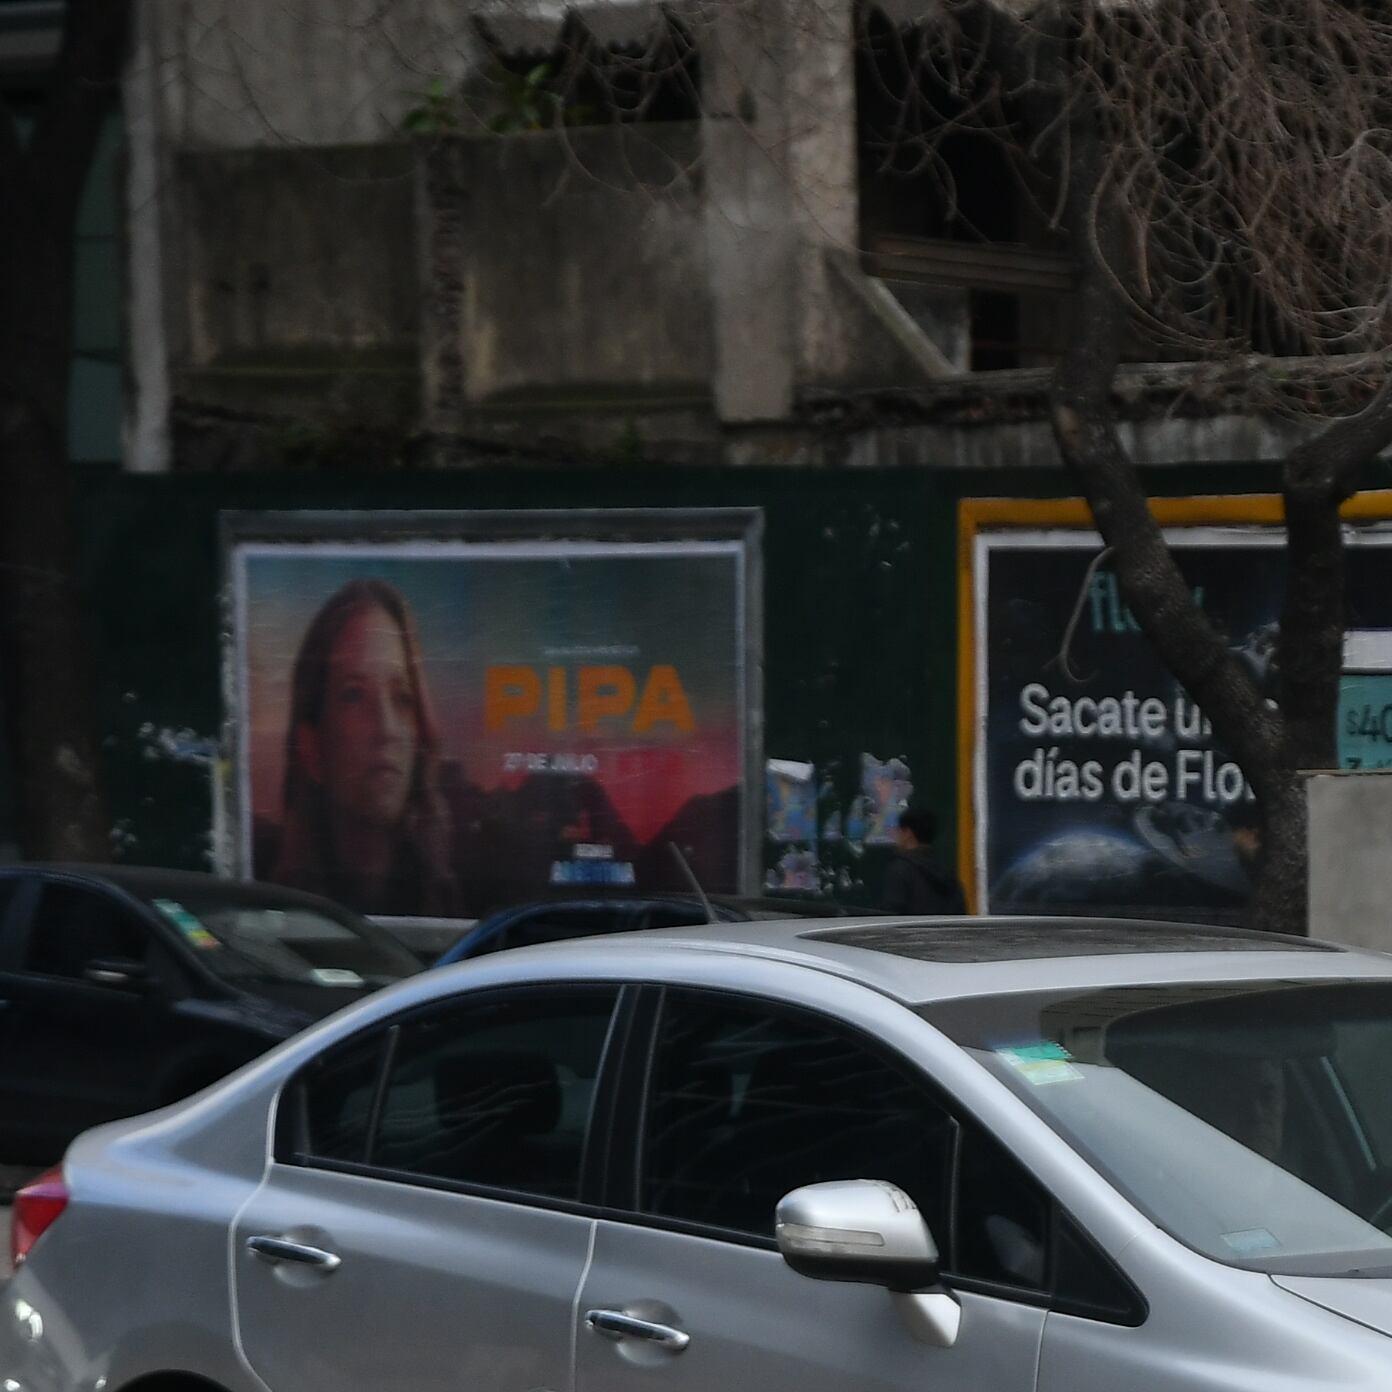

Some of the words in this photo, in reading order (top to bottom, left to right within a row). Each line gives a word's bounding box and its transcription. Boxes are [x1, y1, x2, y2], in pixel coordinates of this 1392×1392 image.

[486, 664, 695, 734] PIPA
[1020, 683, 1168, 739] Sacate
[1175, 698, 1213, 739] u
[1014, 746, 1104, 799] días
[1113, 749, 1169, 800] de
[1177, 749, 1257, 800] Flo
